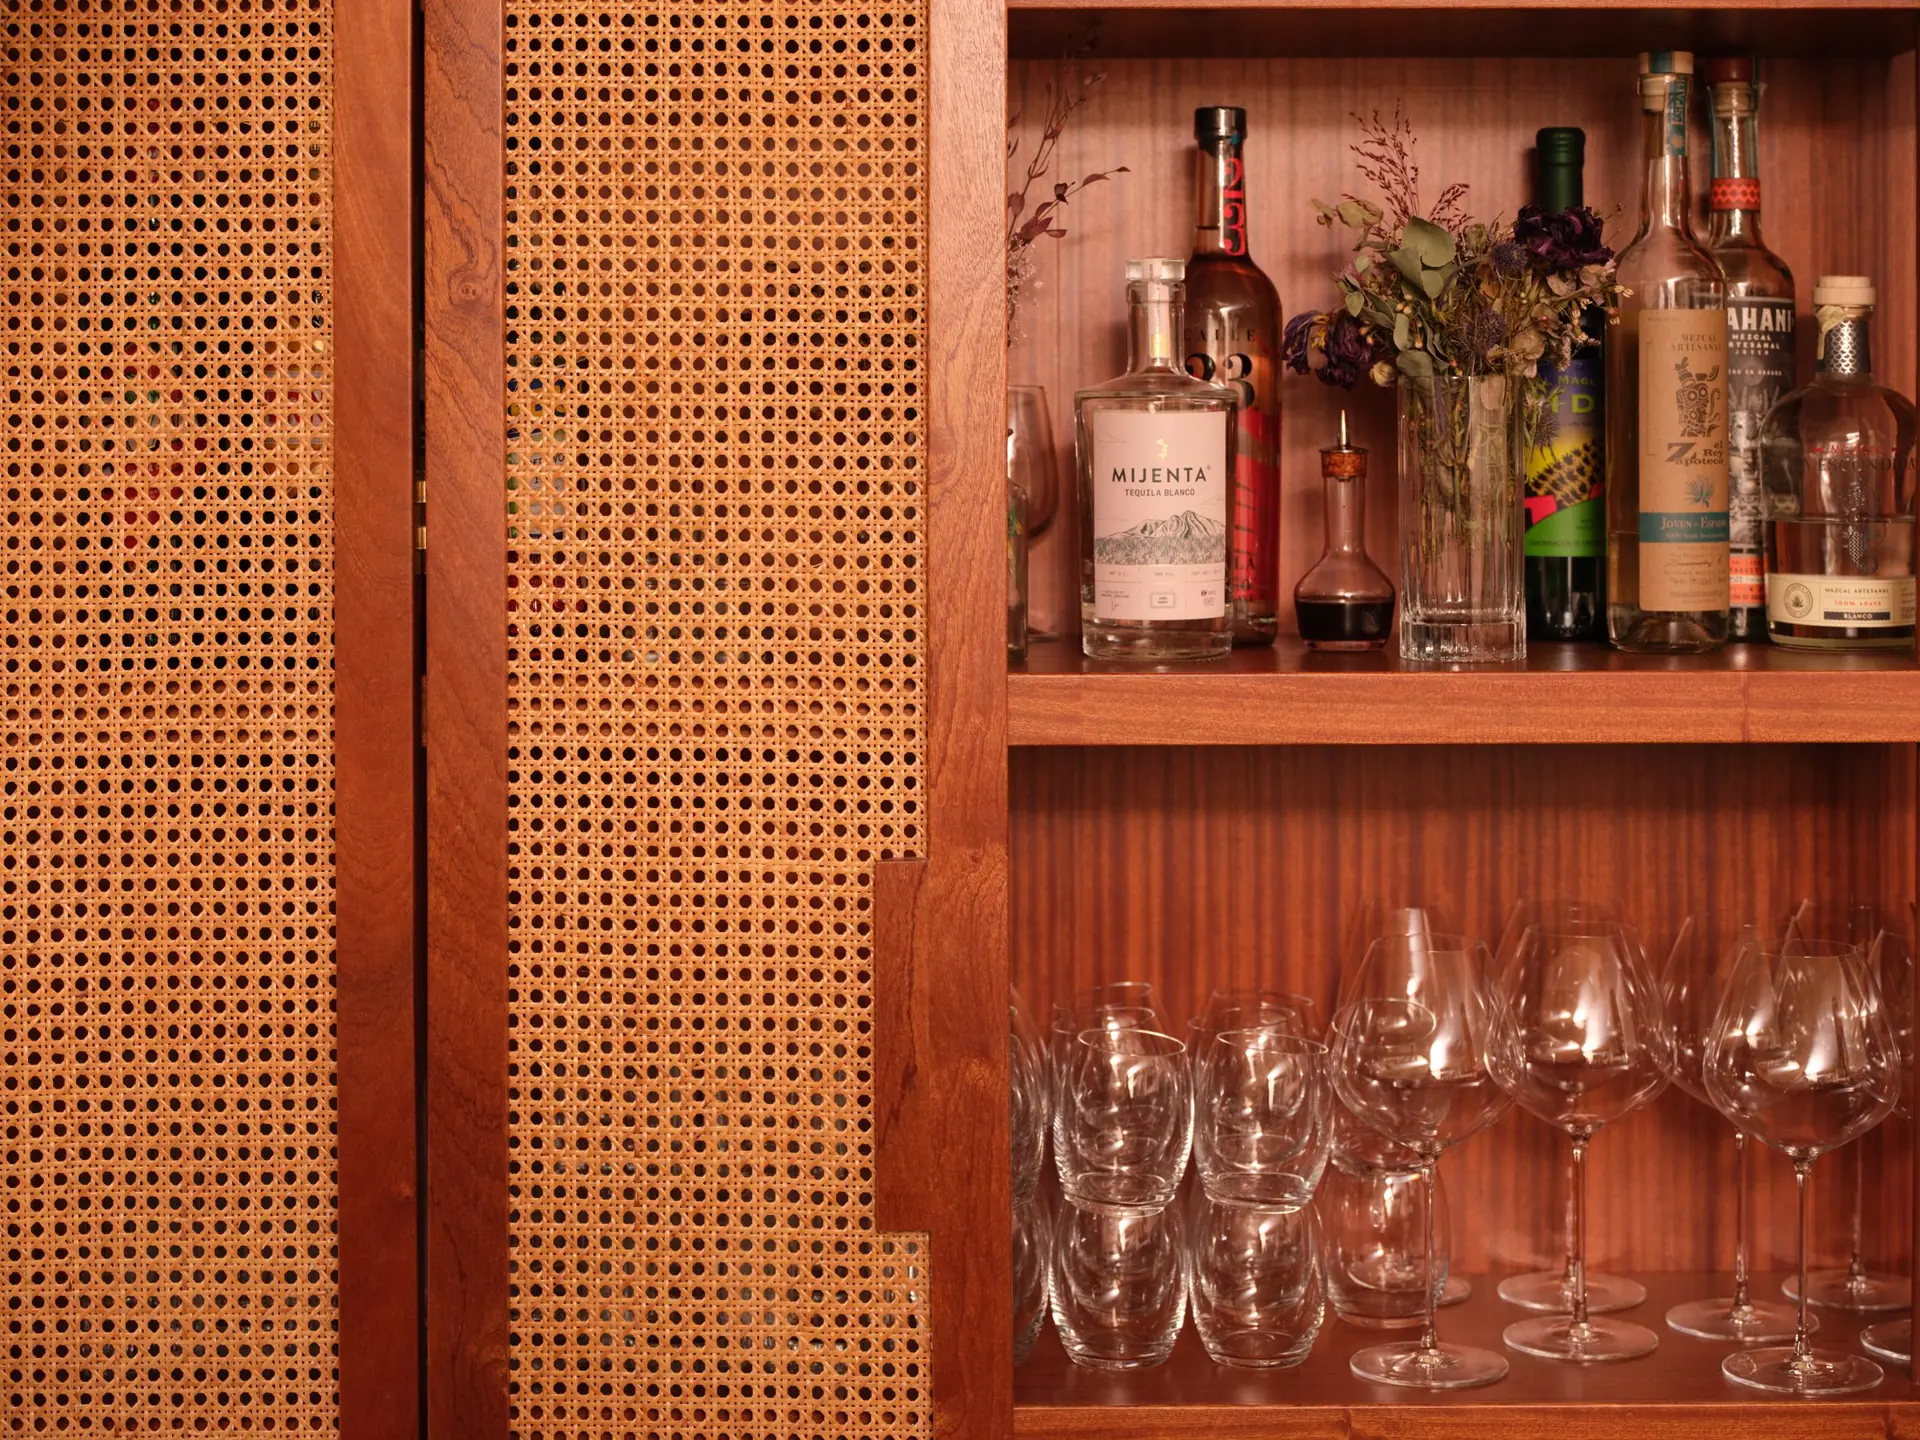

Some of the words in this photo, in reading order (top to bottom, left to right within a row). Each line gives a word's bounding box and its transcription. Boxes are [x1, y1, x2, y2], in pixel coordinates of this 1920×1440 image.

[1223, 158, 1245, 256] 23
[1732, 333, 1771, 341] MEZCAL
[1111, 467, 1208, 483] MIJENTA
[1125, 488, 1162, 497] TEQUILA
[1164, 488, 1195, 497] BLANCO
